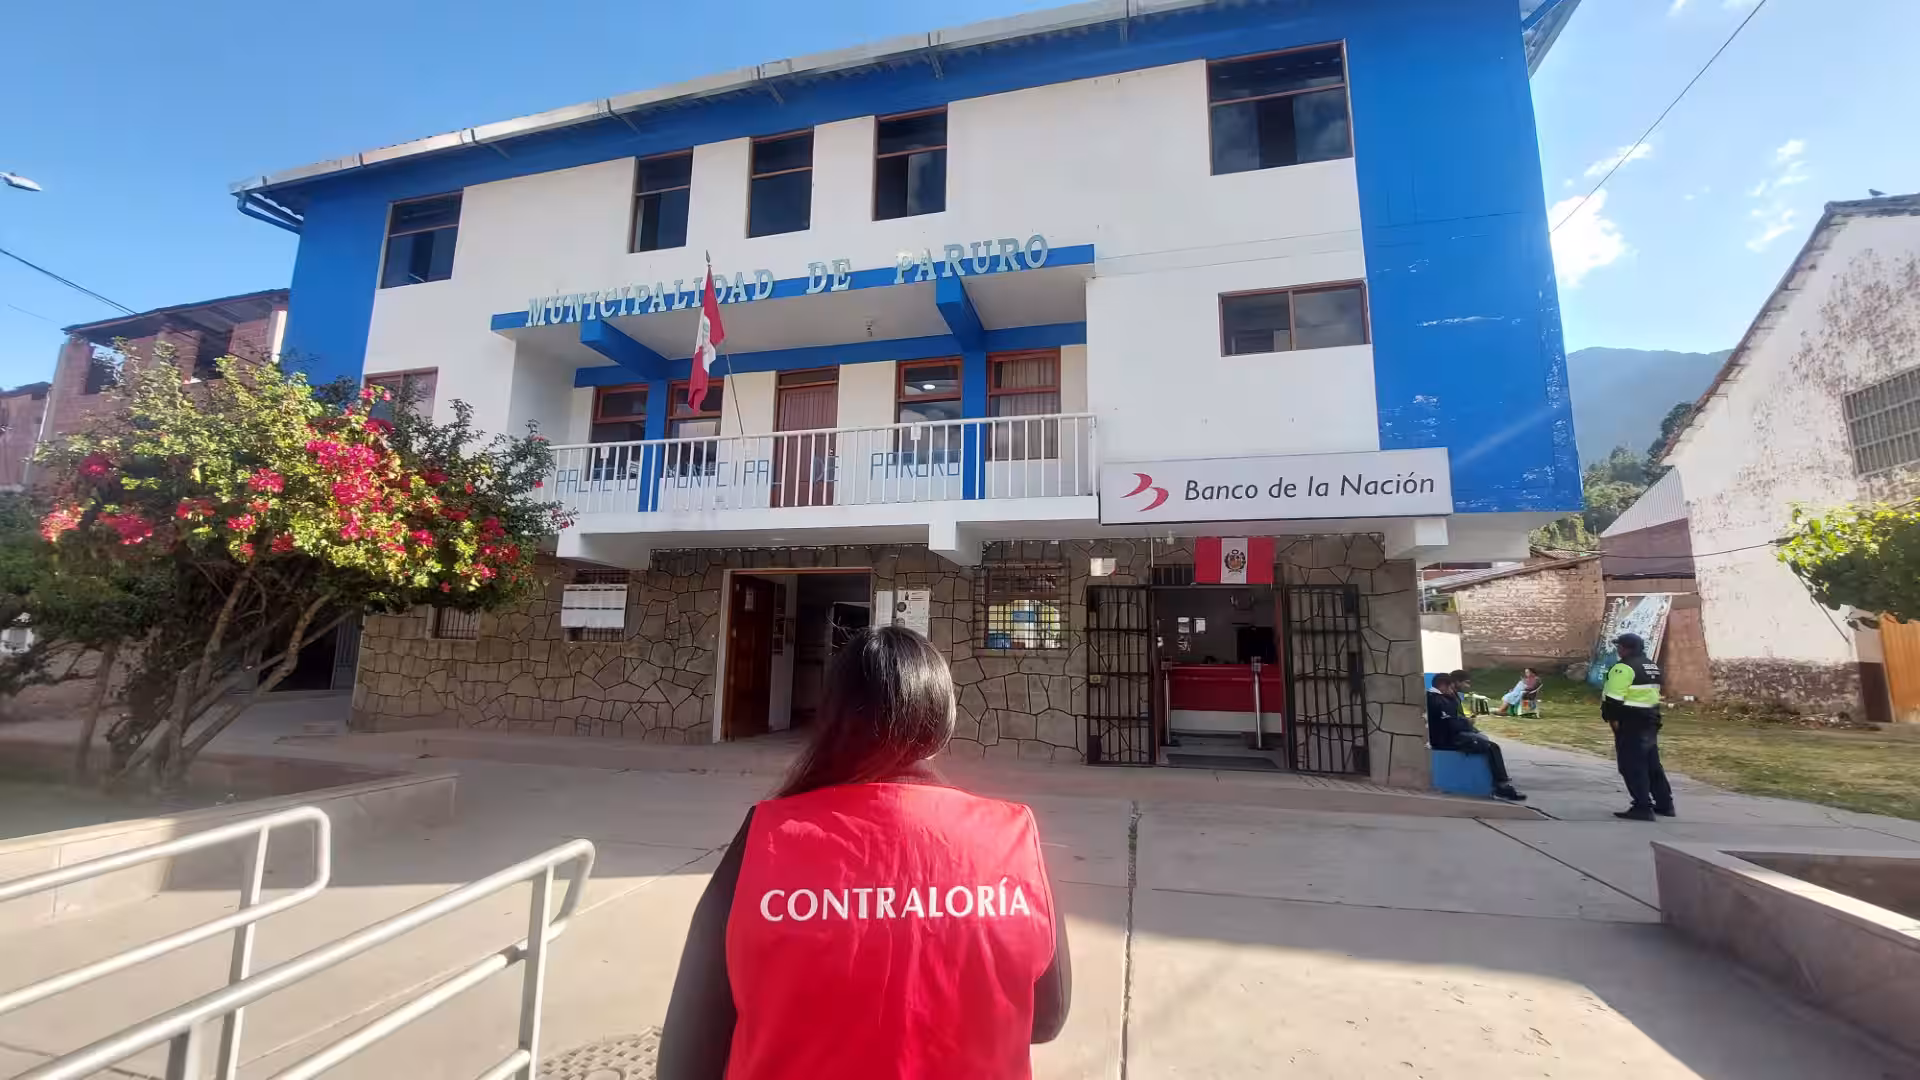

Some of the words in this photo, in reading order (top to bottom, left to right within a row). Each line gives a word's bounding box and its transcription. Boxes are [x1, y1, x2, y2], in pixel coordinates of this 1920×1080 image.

[525, 269, 775, 328] MUNICIPALIDAD
[806, 258, 851, 294] DE
[895, 234, 1049, 284] PARURO
[870, 449, 960, 481] PARURO
[1185, 480, 1258, 501] Banco
[1268, 477, 1297, 498] de
[1307, 475, 1329, 497] la
[1340, 471, 1434, 497] Nación
[760, 877, 1031, 922] CONTRALORÍA
